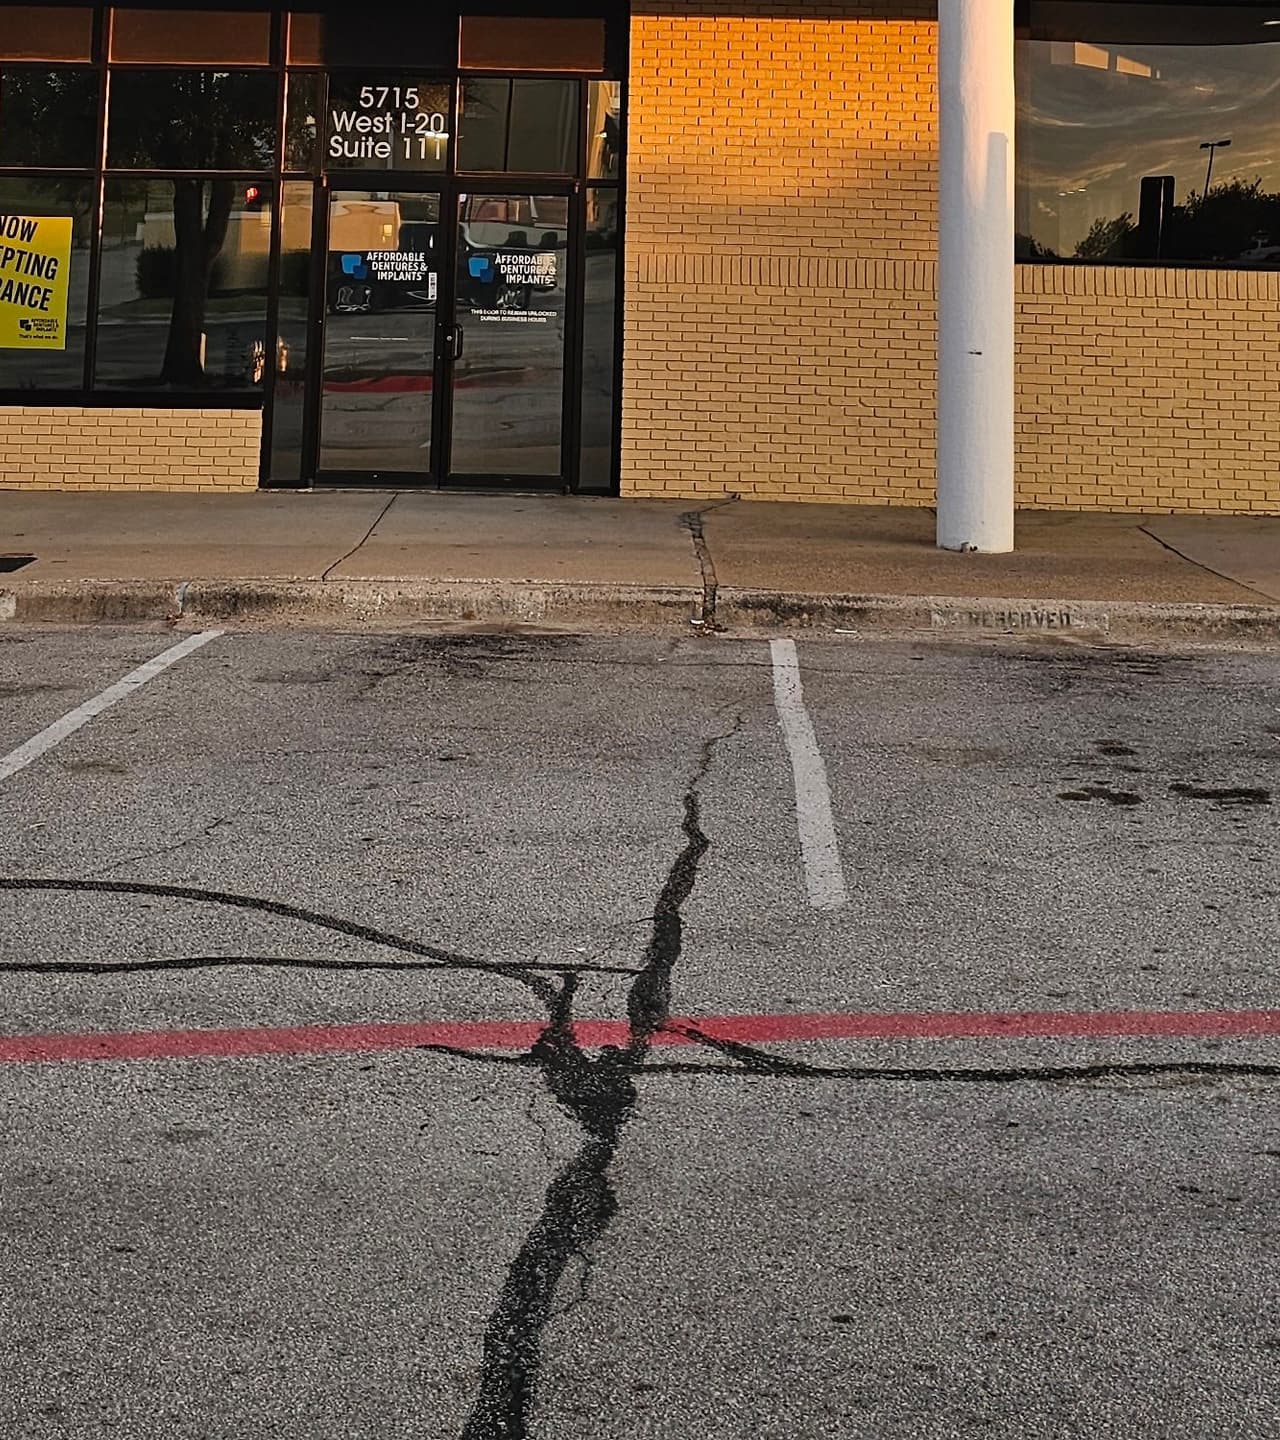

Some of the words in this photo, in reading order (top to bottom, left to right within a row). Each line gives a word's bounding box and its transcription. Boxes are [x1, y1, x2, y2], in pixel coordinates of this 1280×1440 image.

[359, 86, 420, 109] 5715
[332, 110, 393, 133] West
[400, 112, 445, 134] I-20
[329, 135, 391, 158] Suite
[403, 137, 441, 160] 111
[366, 251, 425, 262] AFFORDABLE
[371, 261, 419, 272] DENTURES
[420, 262, 429, 271] &
[377, 271, 423, 281] IMPLANTS
[506, 274, 550, 284] IMPLANTS
